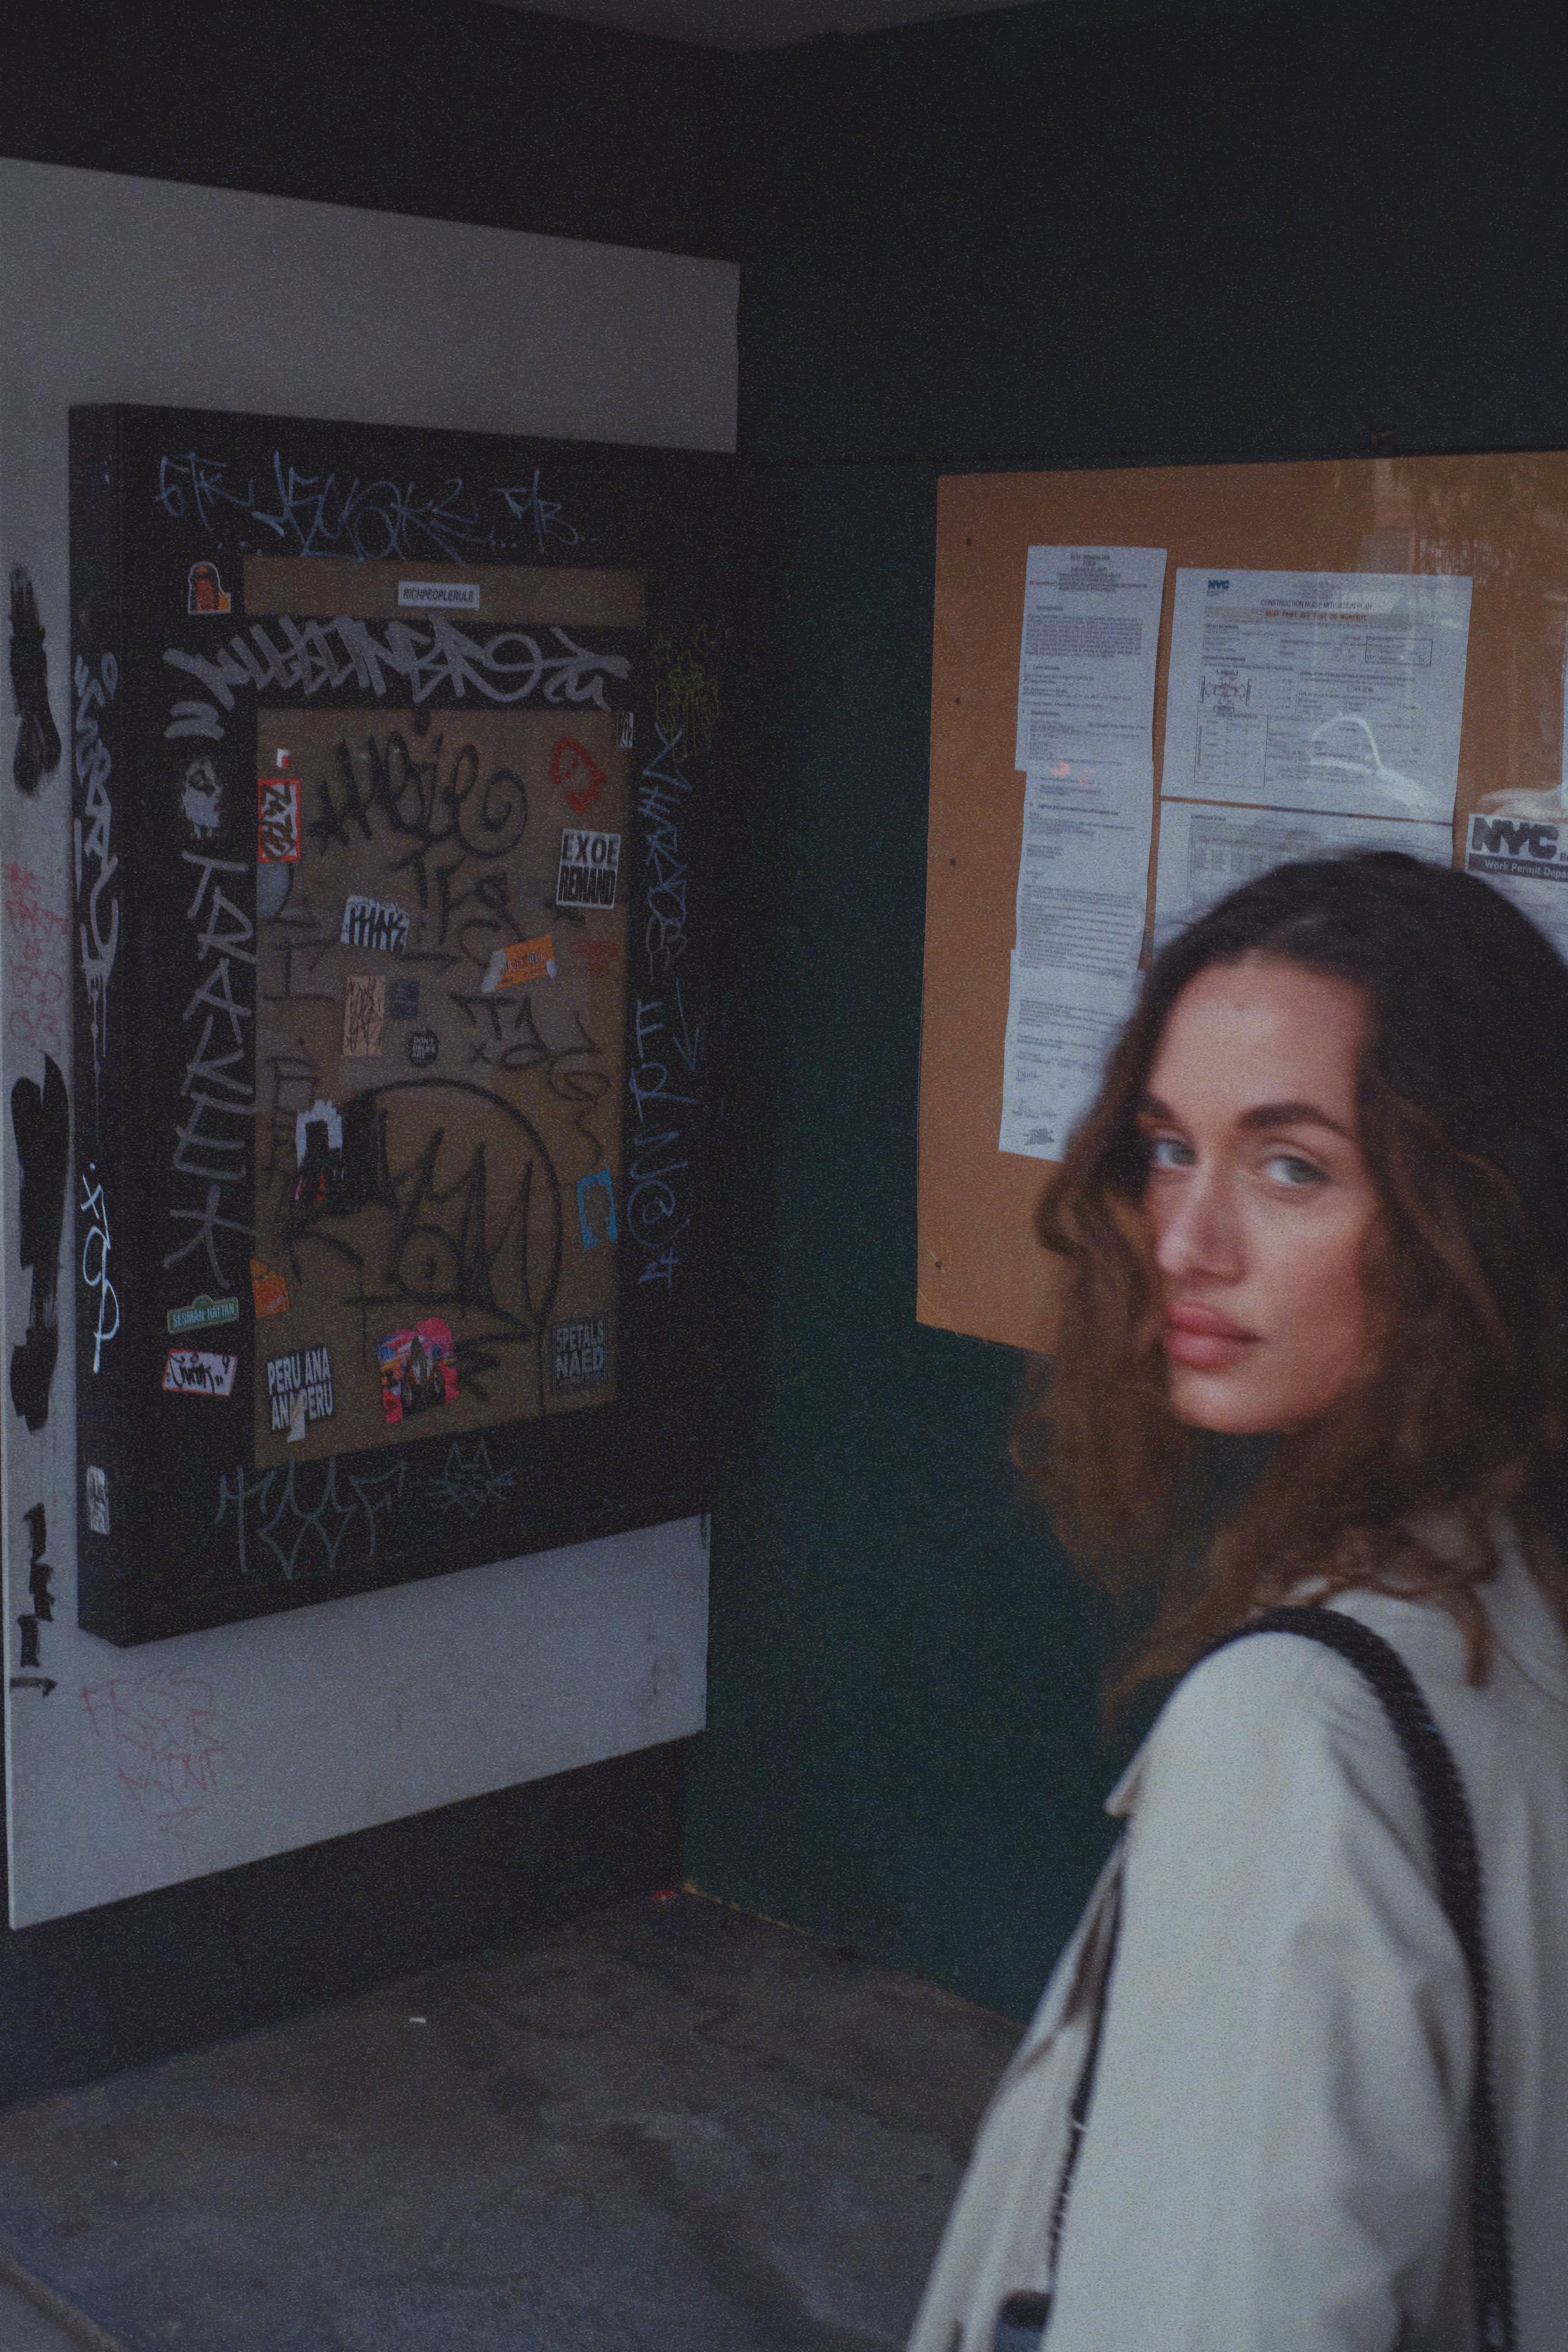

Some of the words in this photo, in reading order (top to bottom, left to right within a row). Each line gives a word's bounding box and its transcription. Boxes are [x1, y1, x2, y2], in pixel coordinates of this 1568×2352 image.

[403, 587, 474, 603] RICHPEOPLERULE
[1207, 579, 1230, 590] NYC
[1472, 817, 1558, 860] NYC
[1485, 859, 1509, 870] Work
[1511, 862, 1541, 875] Permit
[557, 865, 616, 905] REMAND
[172, 1310, 205, 1329] SESMAN
[207, 1303, 235, 1321] HATTAN
[267, 1353, 301, 1395] PERU
[304, 1346, 331, 1386] ANA
[556, 1346, 605, 1379] NAED
